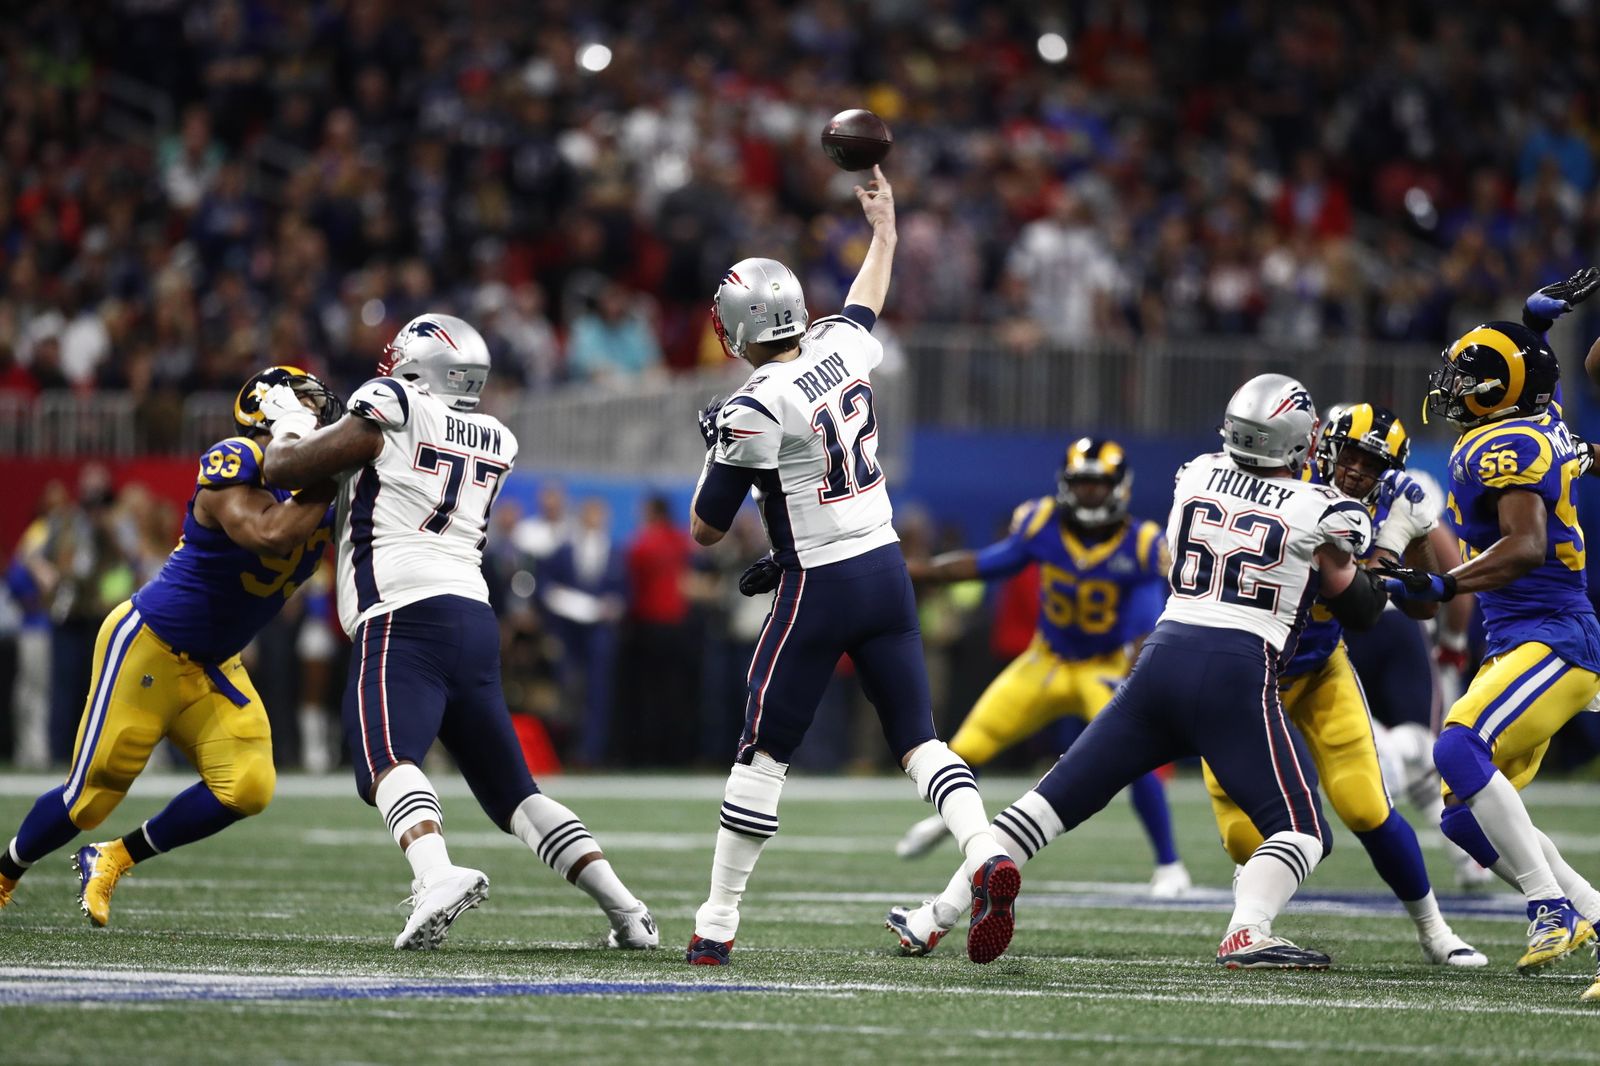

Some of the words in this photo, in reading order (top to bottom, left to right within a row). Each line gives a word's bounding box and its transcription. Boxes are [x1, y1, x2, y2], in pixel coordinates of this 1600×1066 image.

[774, 310, 793, 327] 12
[793, 352, 850, 403] BRADY
[445, 415, 502, 456] BROWN
[811, 379, 887, 505] 12
[1232, 431, 1254, 448] 62
[206, 450, 242, 478] 93
[1478, 449, 1519, 479] 56
[414, 442, 510, 551] 77
[1206, 467, 1296, 510] THUNEY
[1170, 496, 1290, 615] 62
[1041, 563, 1120, 635] 58
